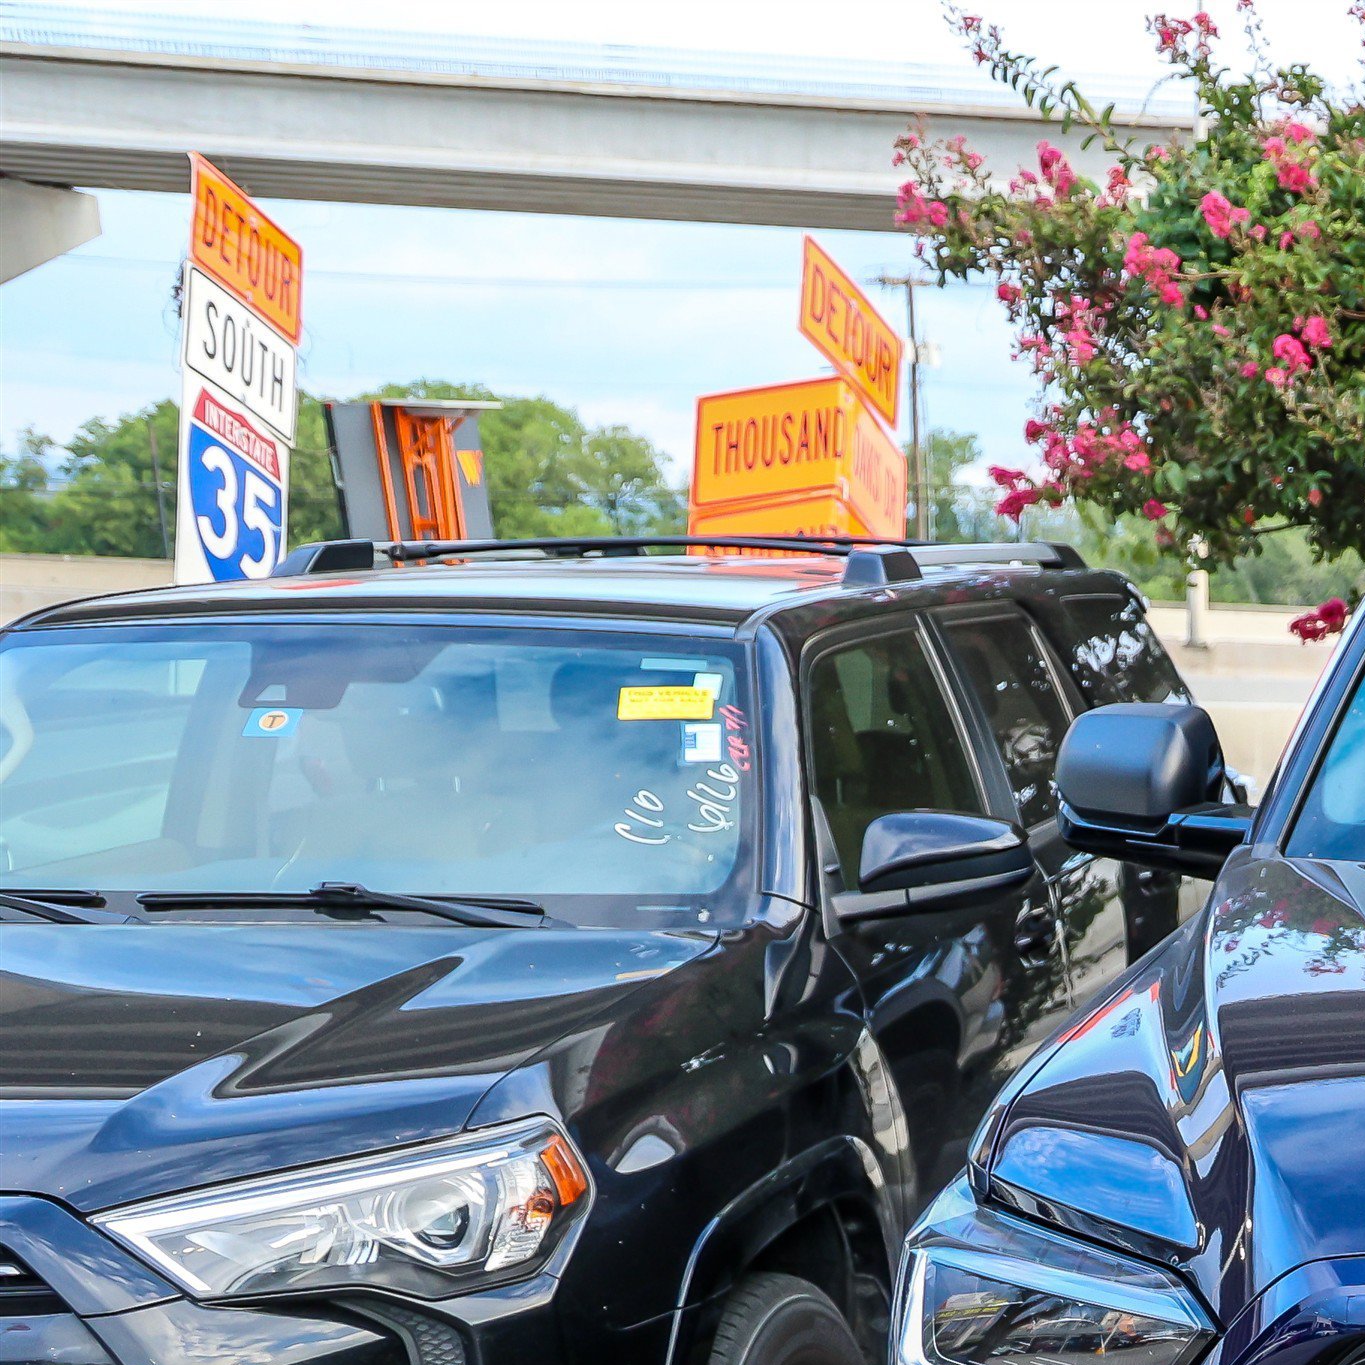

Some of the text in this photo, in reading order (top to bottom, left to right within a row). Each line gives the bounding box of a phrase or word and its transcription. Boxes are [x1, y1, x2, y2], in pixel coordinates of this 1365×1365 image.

[203, 185, 293, 316] DETOUR
[203, 301, 284, 412] SOUTH
[810, 263, 891, 401] DETOUR
[204, 399, 277, 471] INTERSTATE
[713, 407, 845, 476] THOUSAND
[197, 445, 276, 579] 35
